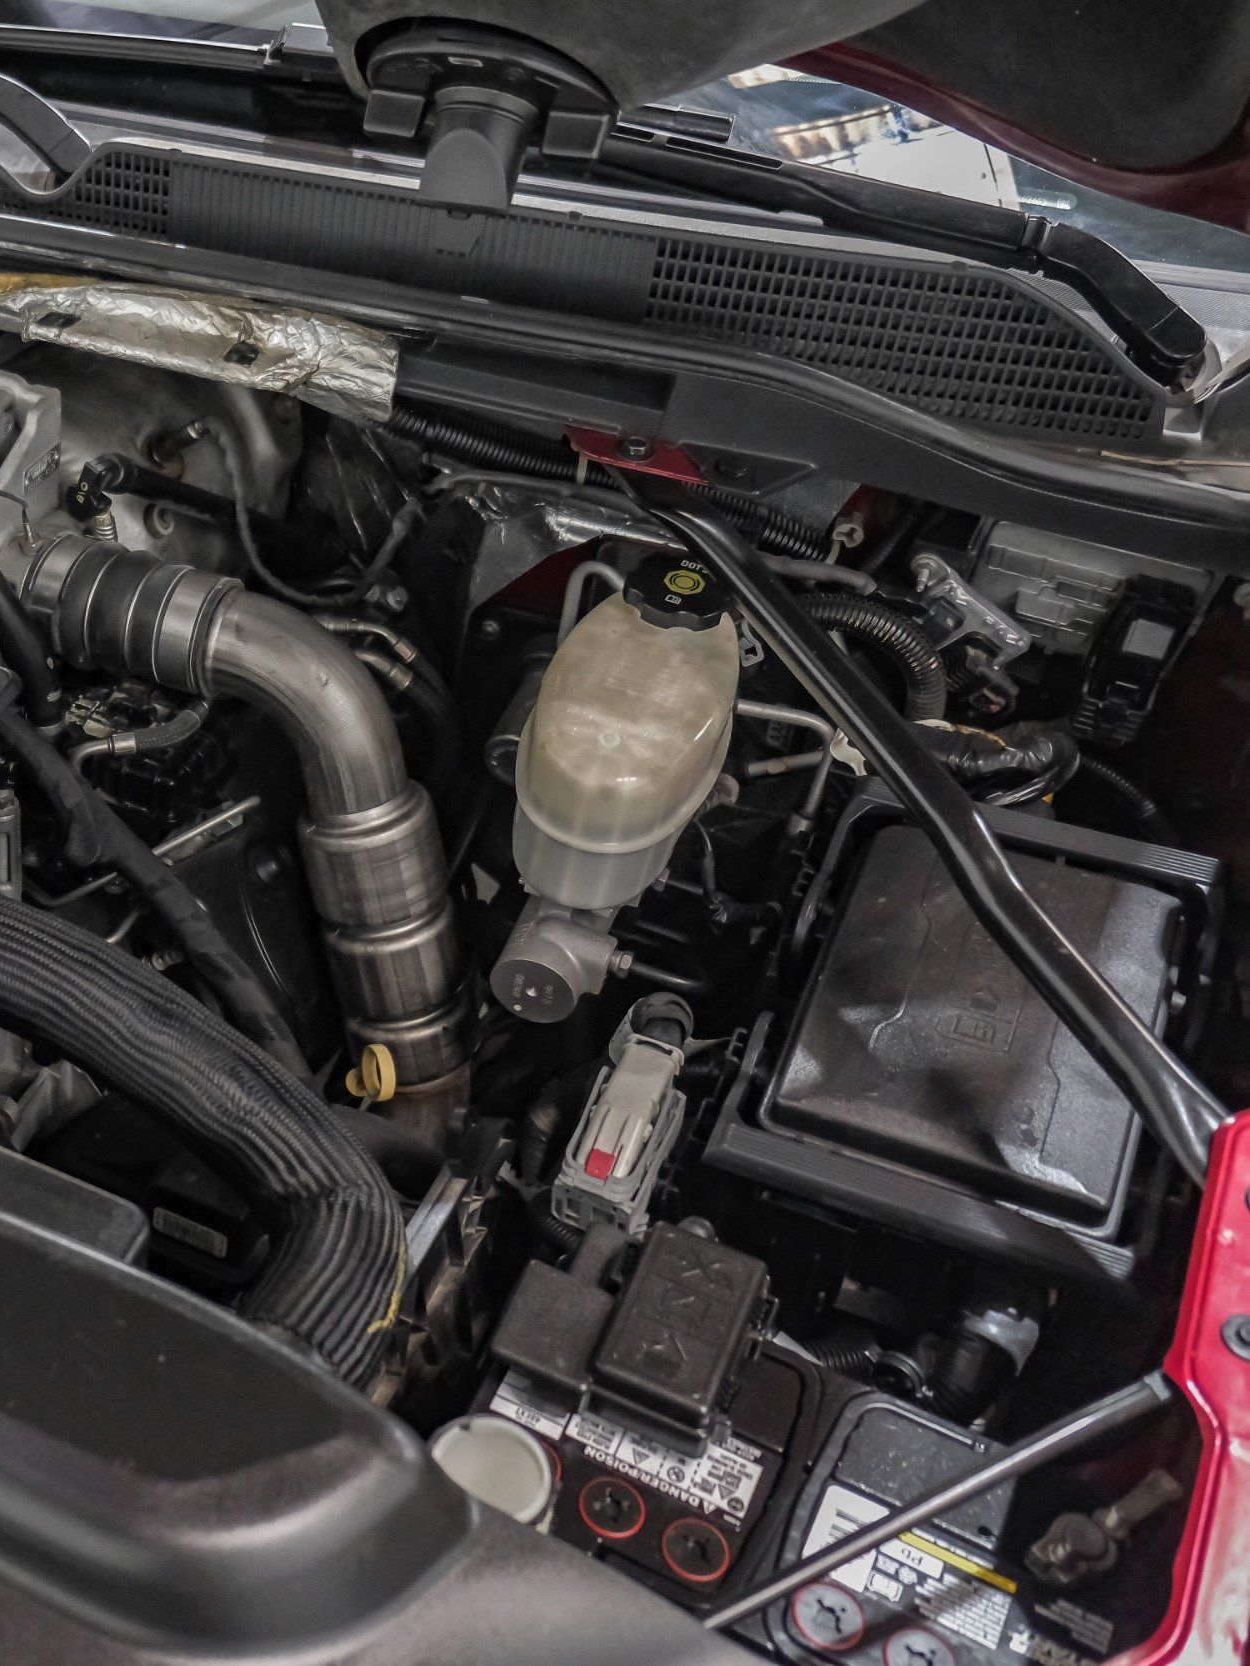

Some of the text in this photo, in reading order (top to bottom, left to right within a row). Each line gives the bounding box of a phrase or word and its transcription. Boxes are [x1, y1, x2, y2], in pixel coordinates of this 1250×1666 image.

[680, 560, 701, 570] DOT
[583, 1444, 702, 1506] DANGER/POISON
[900, 1547, 924, 1566] Pb
